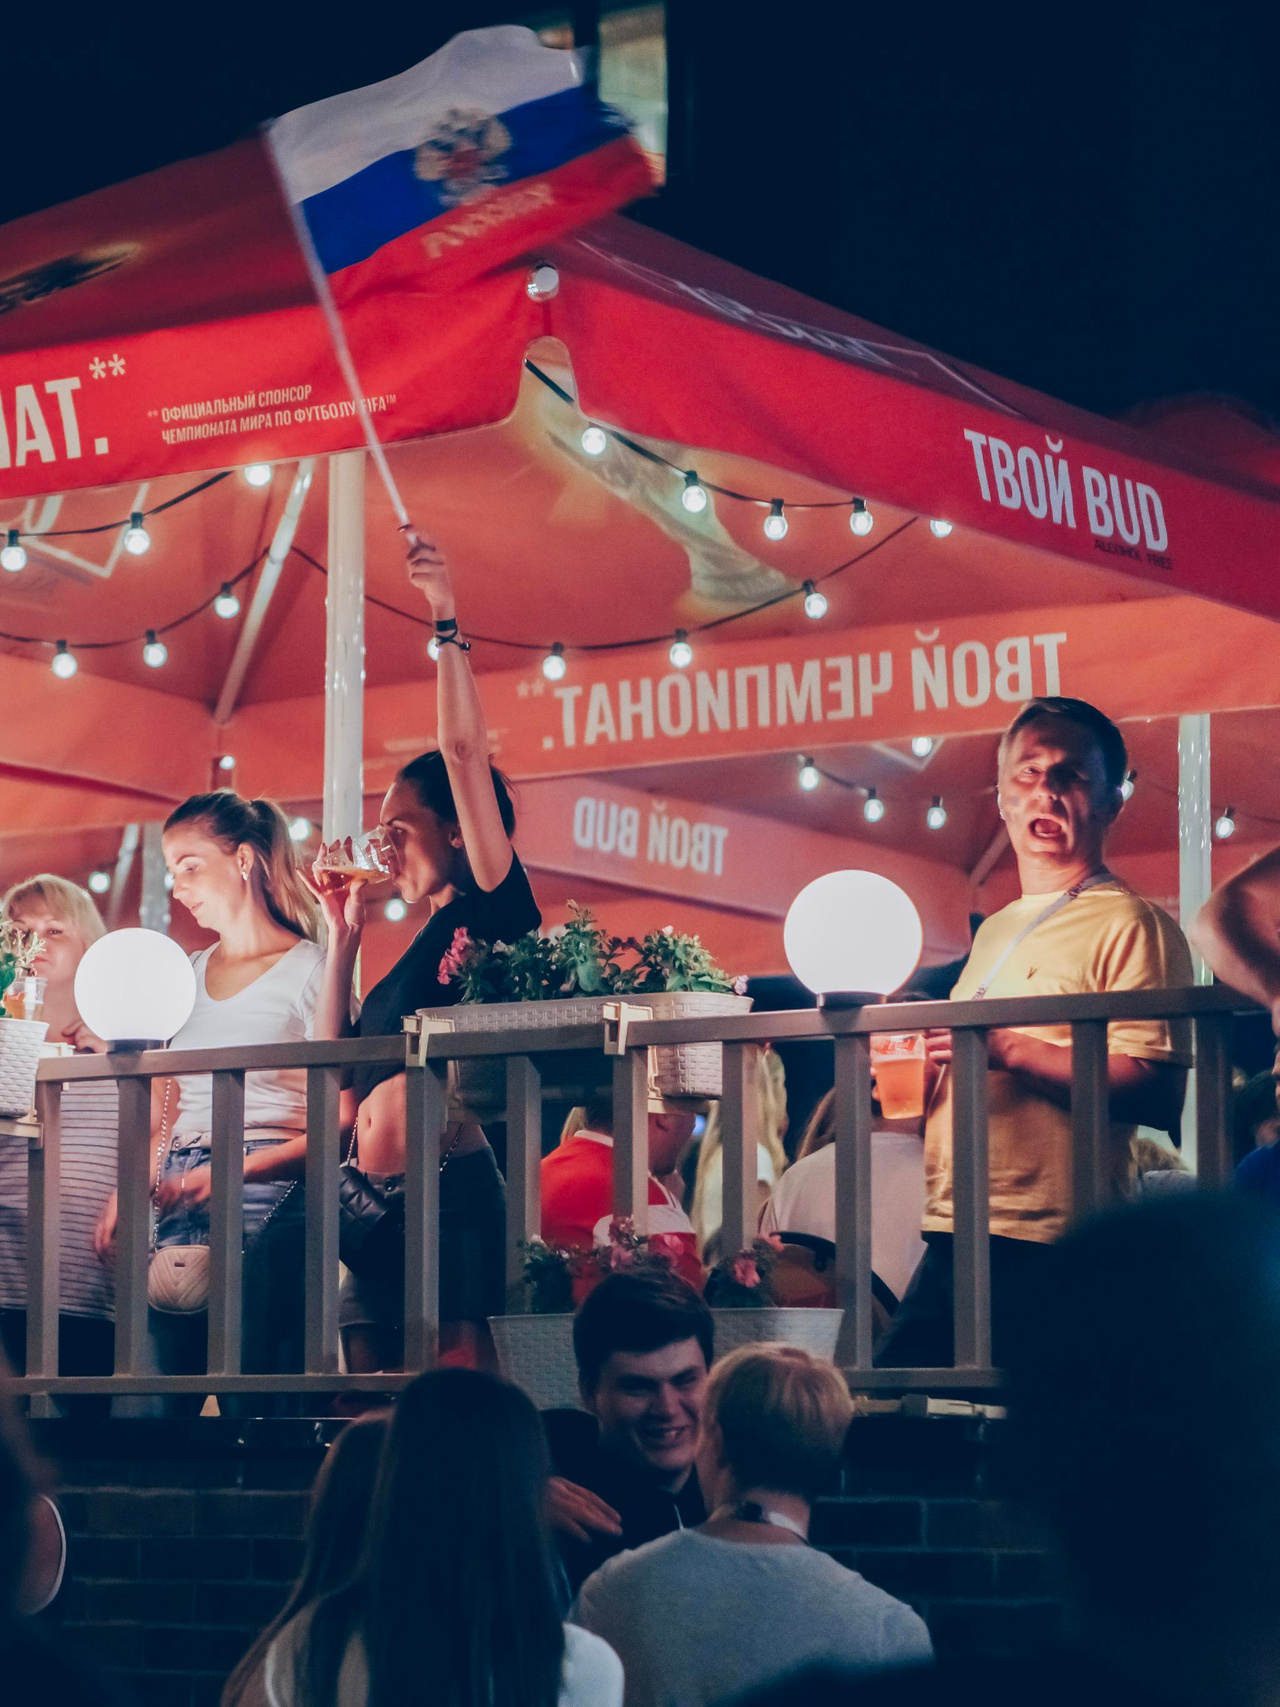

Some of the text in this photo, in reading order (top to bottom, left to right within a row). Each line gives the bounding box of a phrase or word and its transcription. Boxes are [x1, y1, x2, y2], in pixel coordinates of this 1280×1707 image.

[161, 390, 256, 423] ОФИЦИАЛЬНЫЙ
[258, 384, 312, 407] СПОНСОР
[162, 418, 237, 445] ЧЕМПИОНАТА
[240, 411, 273, 433] МИРА
[275, 408, 292, 426] ПО
[294, 399, 356, 424] ФУТБОЛУ
[963, 428, 1168, 552] ТВОЙ BUD
